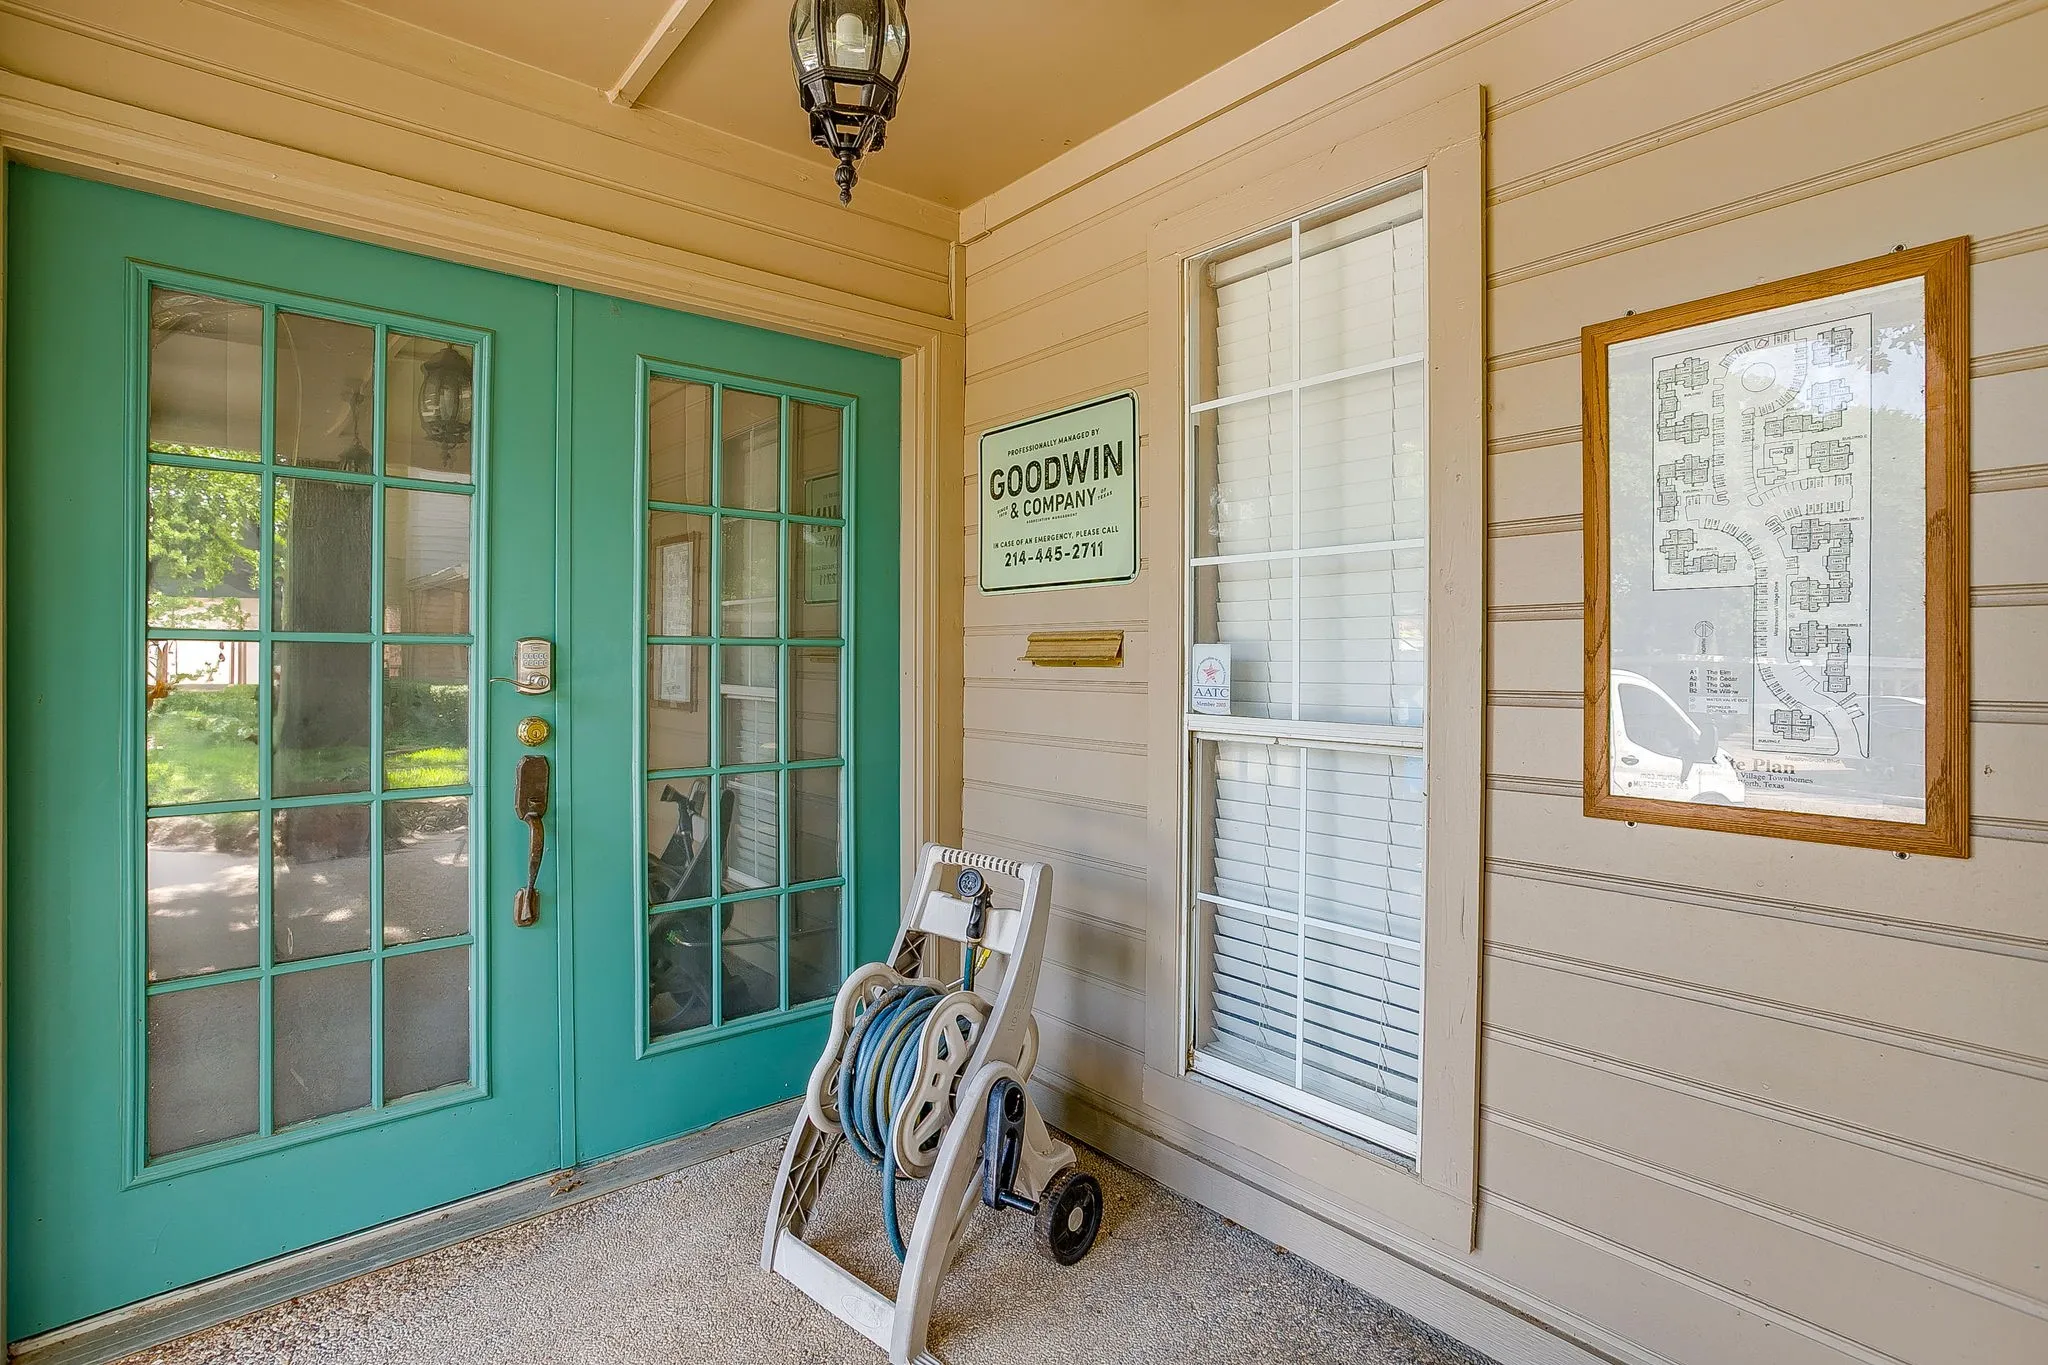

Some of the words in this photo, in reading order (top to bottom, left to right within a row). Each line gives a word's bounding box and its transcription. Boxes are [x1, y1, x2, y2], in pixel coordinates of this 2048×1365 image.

[1008, 438, 1057, 456] PROFESSIONALLY
[1058, 430, 1090, 445] MANAGED
[1091, 428, 1100, 436] BY
[990, 440, 1123, 500] GOODWIN
[1010, 502, 1019, 519] &
[1024, 487, 1096, 516] COMPANY
[1097, 491, 1113, 500] TEXAS
[997, 506, 1008, 514] SINCE
[1000, 540, 1015, 548] CASE
[1034, 532, 1074, 544] EMERGENCY,
[1076, 528, 1100, 538] PLEASE
[1102, 525, 1119, 534] CALL
[1005, 541, 1103, 567] 214-445-2711
[1194, 688, 1229, 698] AATC
[1752, 758, 1795, 774] Plan
[1741, 773, 1766, 781] Village
[1768, 775, 1814, 784] Townhomes
